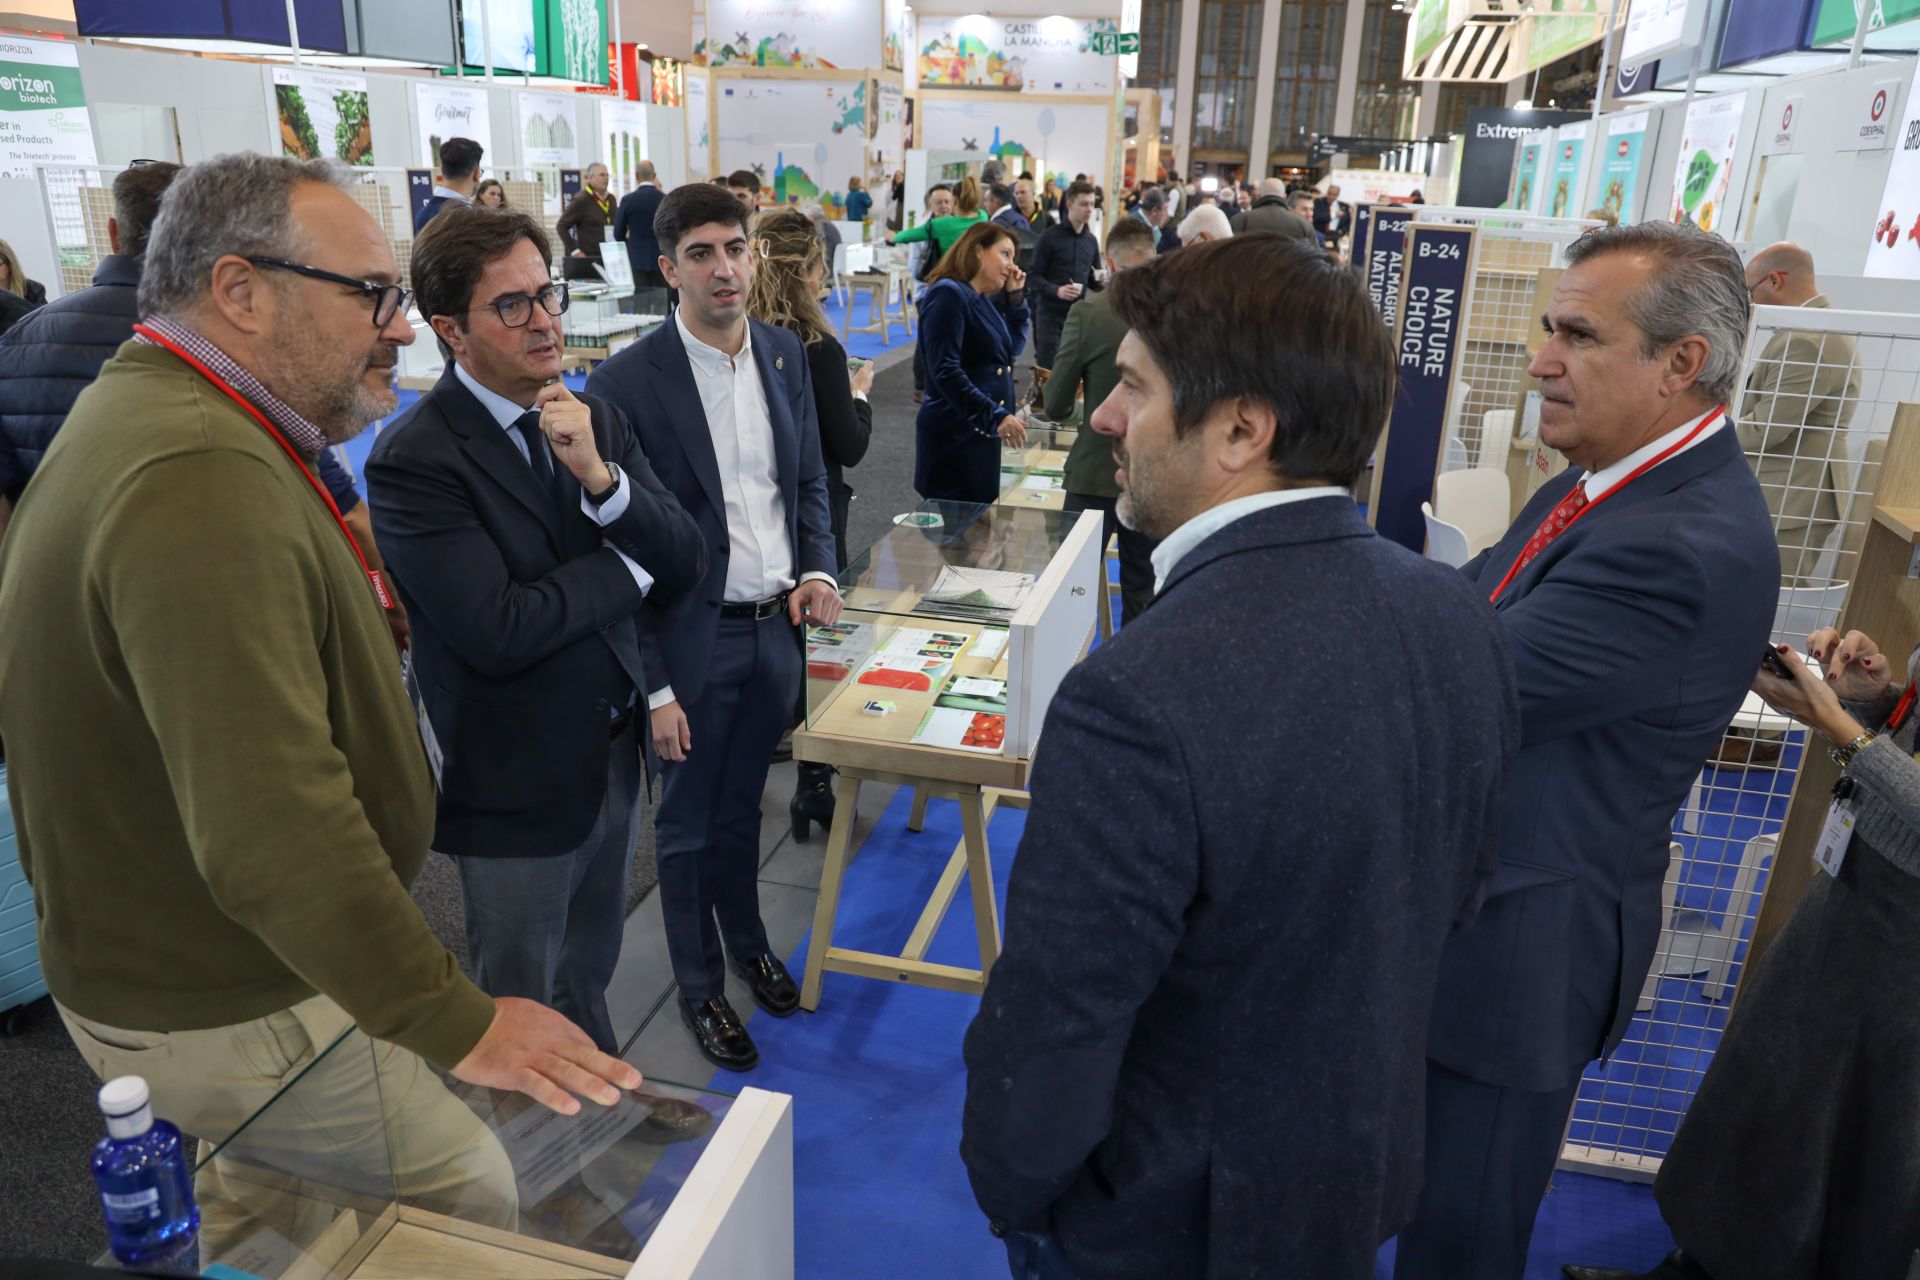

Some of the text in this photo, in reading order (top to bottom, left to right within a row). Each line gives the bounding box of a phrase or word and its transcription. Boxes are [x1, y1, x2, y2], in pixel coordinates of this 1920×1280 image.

[19, 91, 57, 104] biotech
[12, 121, 21, 131] in
[1476, 122, 1541, 140] Extrem
[1859, 125, 1885, 137] COEXPHAL
[16, 134, 54, 145] Products
[9, 151, 21, 160] The
[1419, 242, 1461, 259] B-24
[1383, 250, 1403, 327] ALMAGRO
[1400, 286, 1430, 367] CHOICE
[1423, 287, 1455, 377] NATURE
[1535, 447, 1549, 476] Spain
